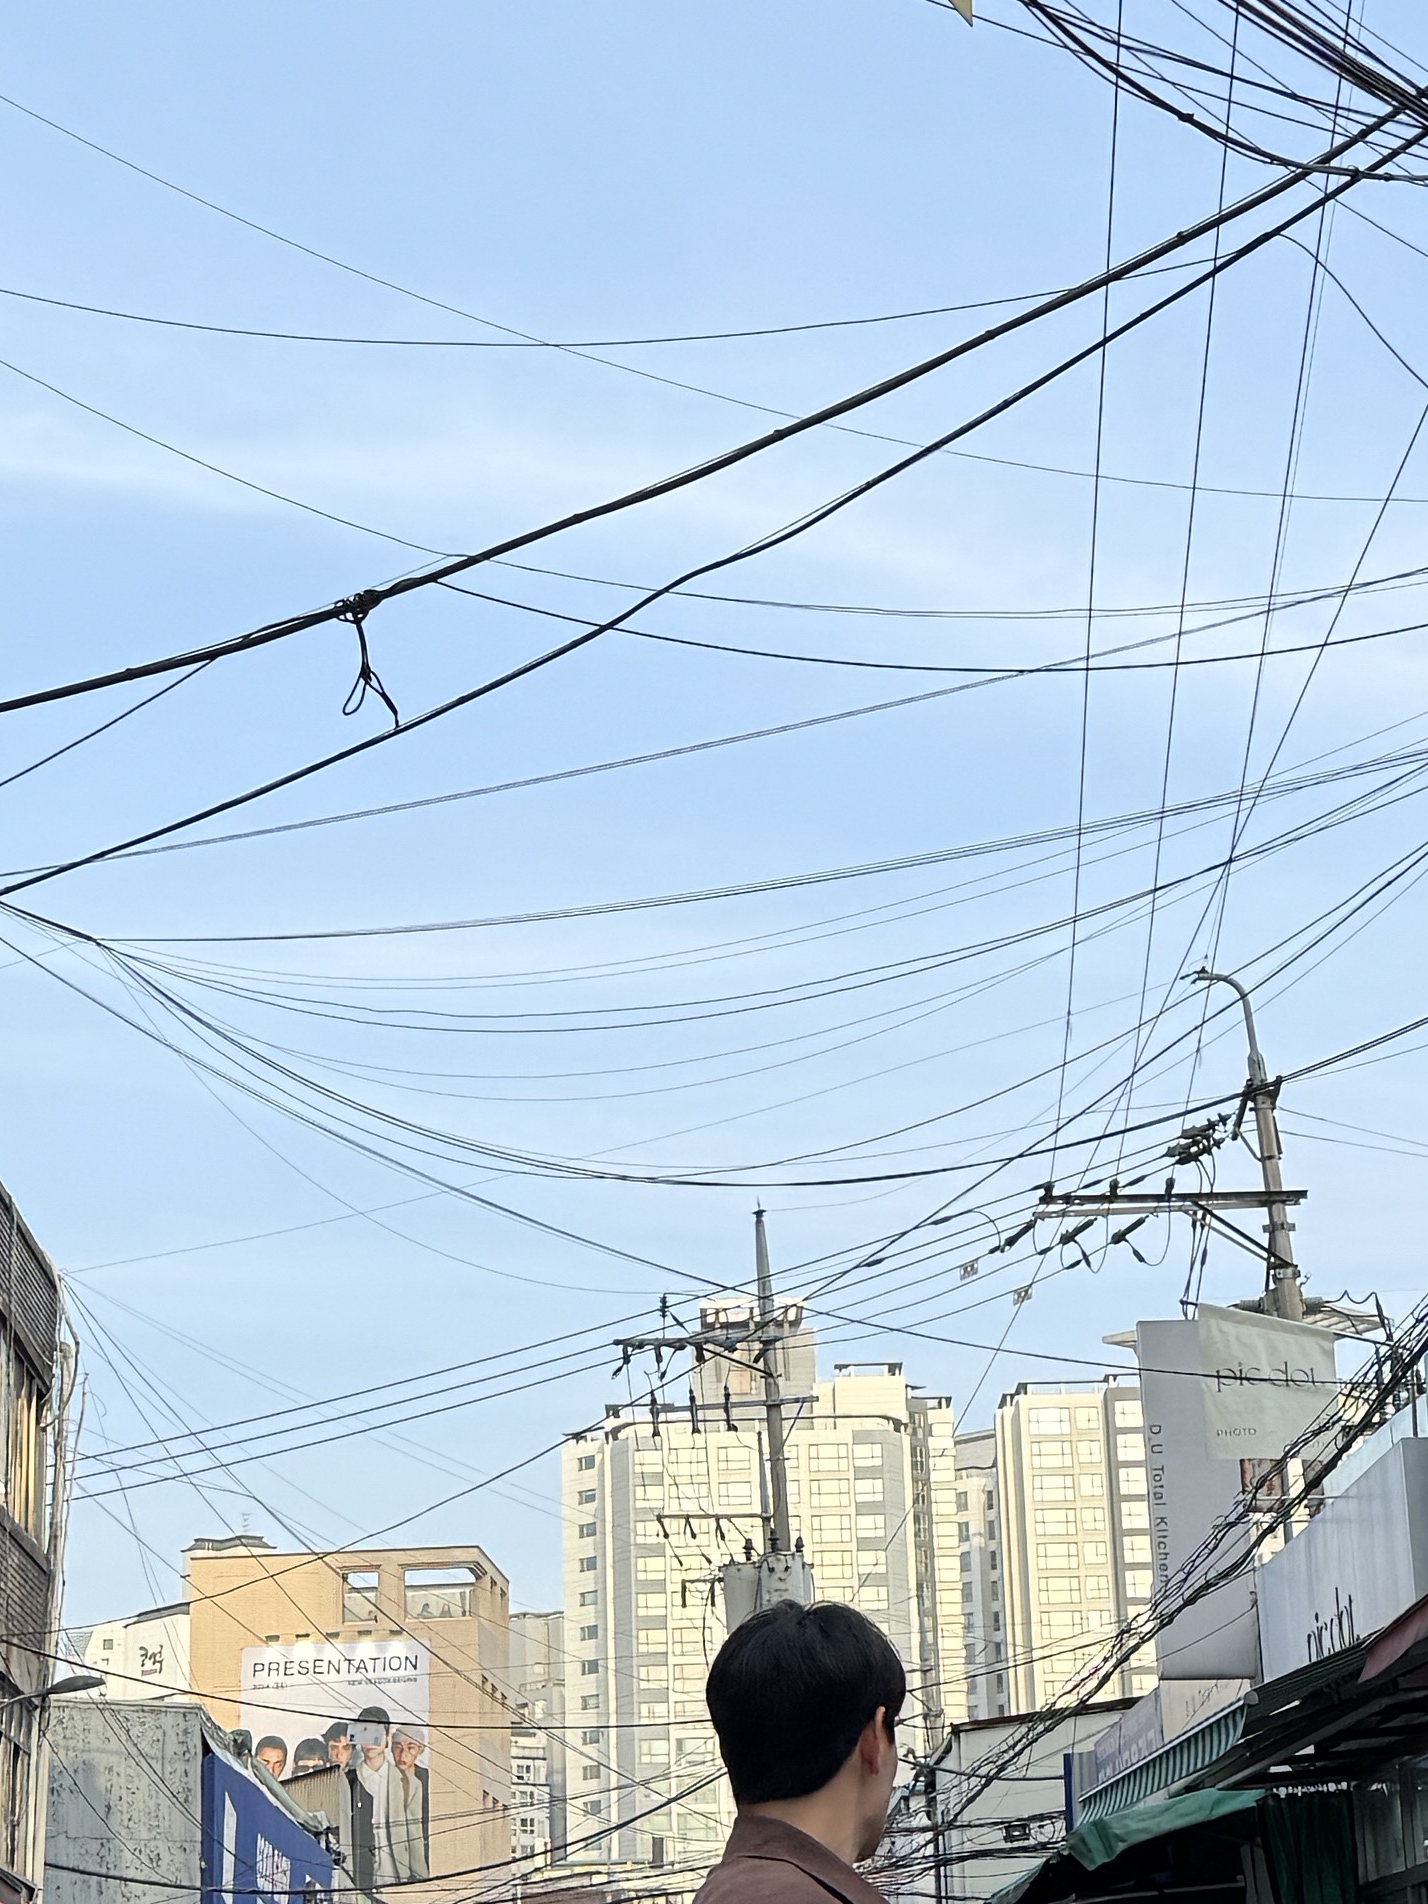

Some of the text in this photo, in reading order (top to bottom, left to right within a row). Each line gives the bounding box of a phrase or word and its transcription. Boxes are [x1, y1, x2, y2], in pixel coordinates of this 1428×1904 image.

[1216, 1427, 1257, 1438] PHOTO
[1153, 1465, 1167, 1505] Total
[252, 1654, 419, 1679] PRESENTATION
